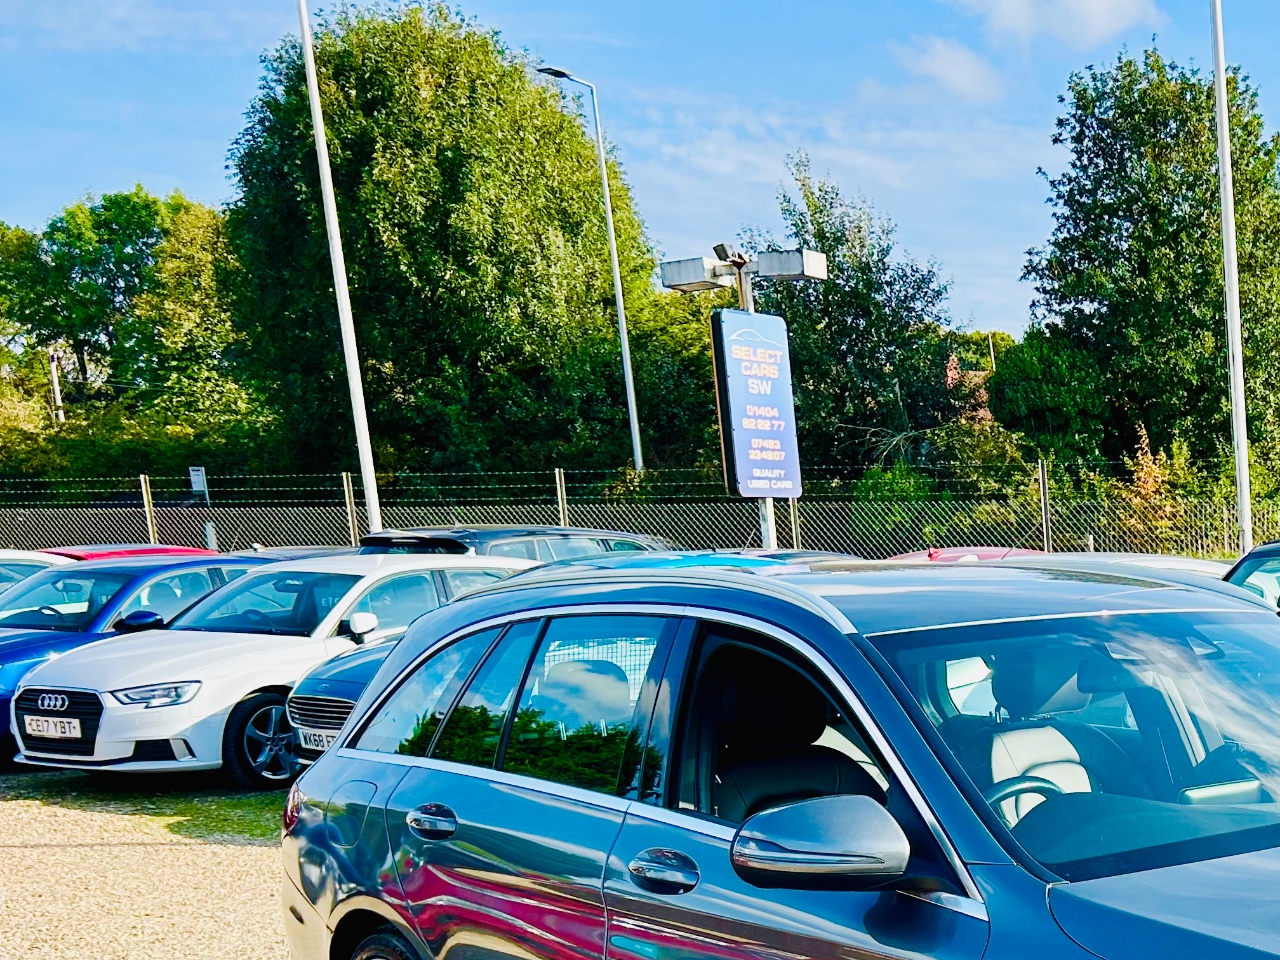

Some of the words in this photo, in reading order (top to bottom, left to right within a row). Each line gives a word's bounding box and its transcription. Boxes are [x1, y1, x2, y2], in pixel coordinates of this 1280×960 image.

[732, 345, 782, 364] SELECT
[741, 361, 779, 379] CARS
[748, 378, 772, 395] SW
[747, 405, 778, 417] 01404
[772, 420, 786, 432] 77
[753, 469, 785, 478] QUALITY
[748, 479, 770, 489] USED
[771, 480, 793, 489] CARS
[29, 718, 49, 734] CE17
[52, 720, 73, 735] YBT
[301, 731, 325, 748] WK68
